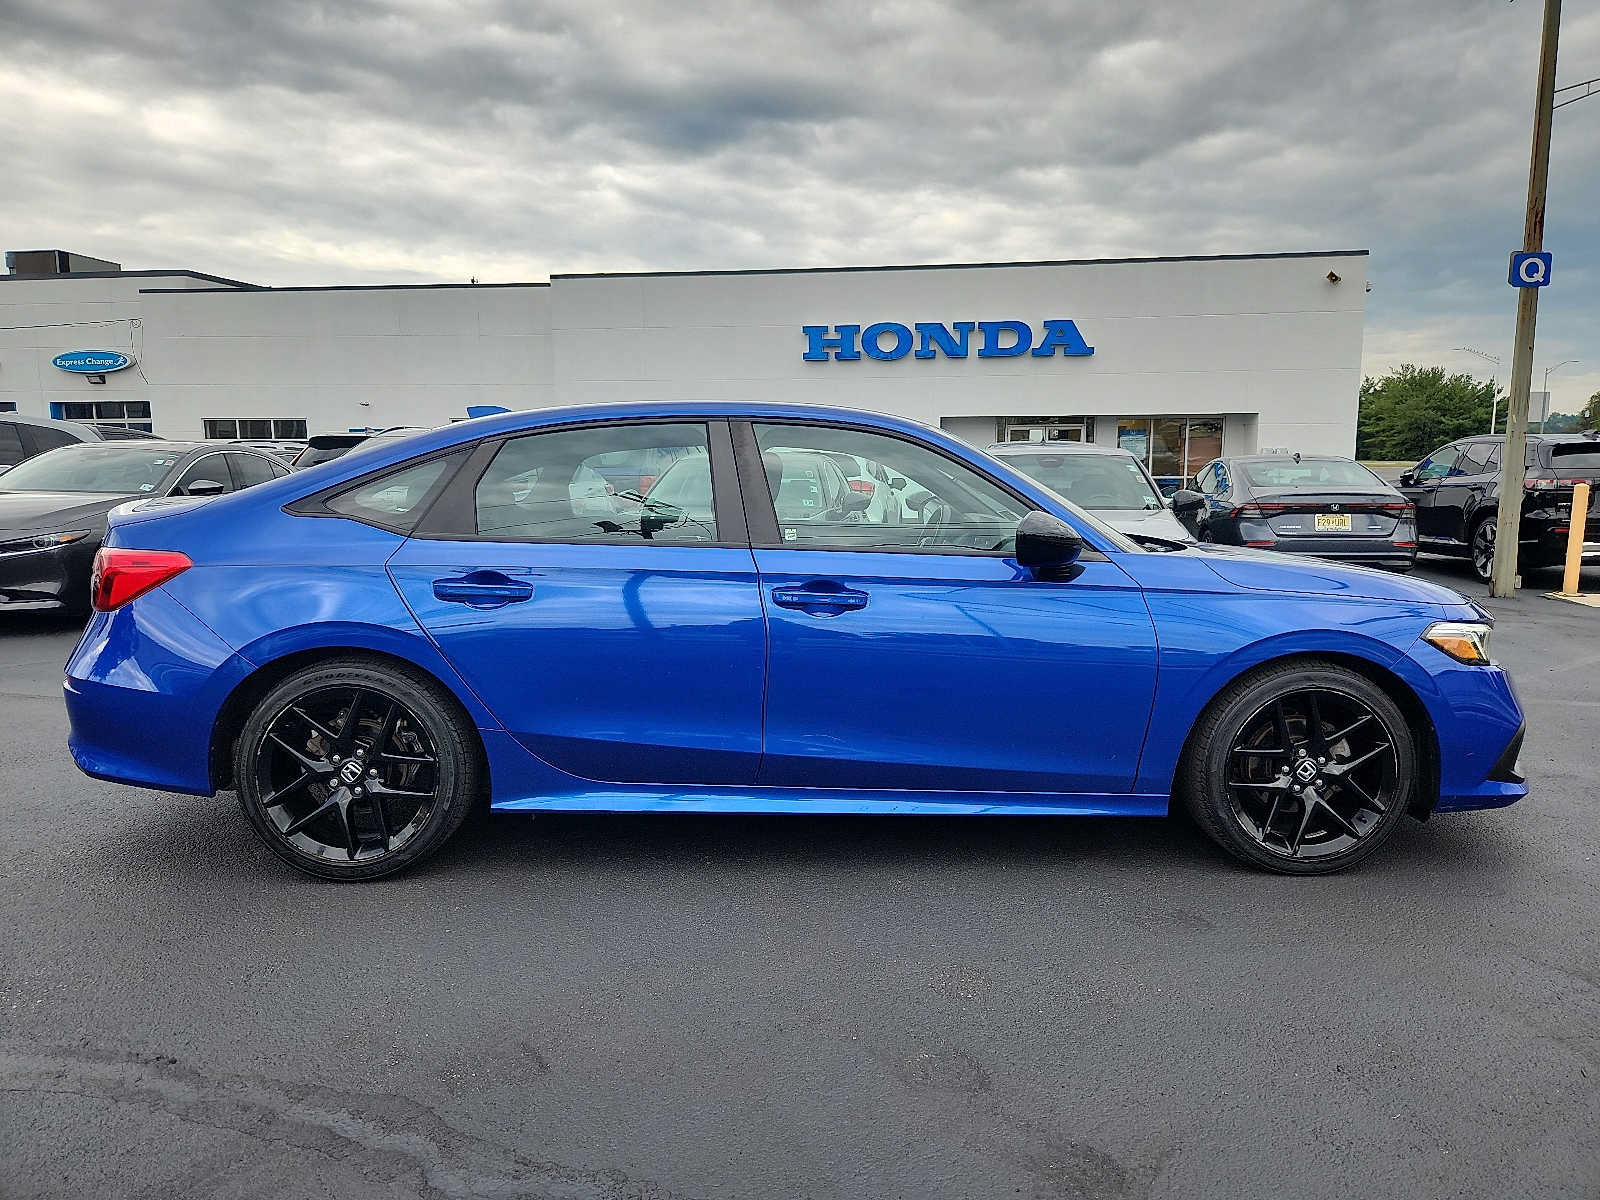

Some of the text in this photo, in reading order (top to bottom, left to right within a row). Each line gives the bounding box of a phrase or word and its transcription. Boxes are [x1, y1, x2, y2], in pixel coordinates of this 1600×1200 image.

[1520, 257, 1545, 282] Q
[802, 319, 1095, 361] HONDA
[56, 357, 113, 367] Express Change
